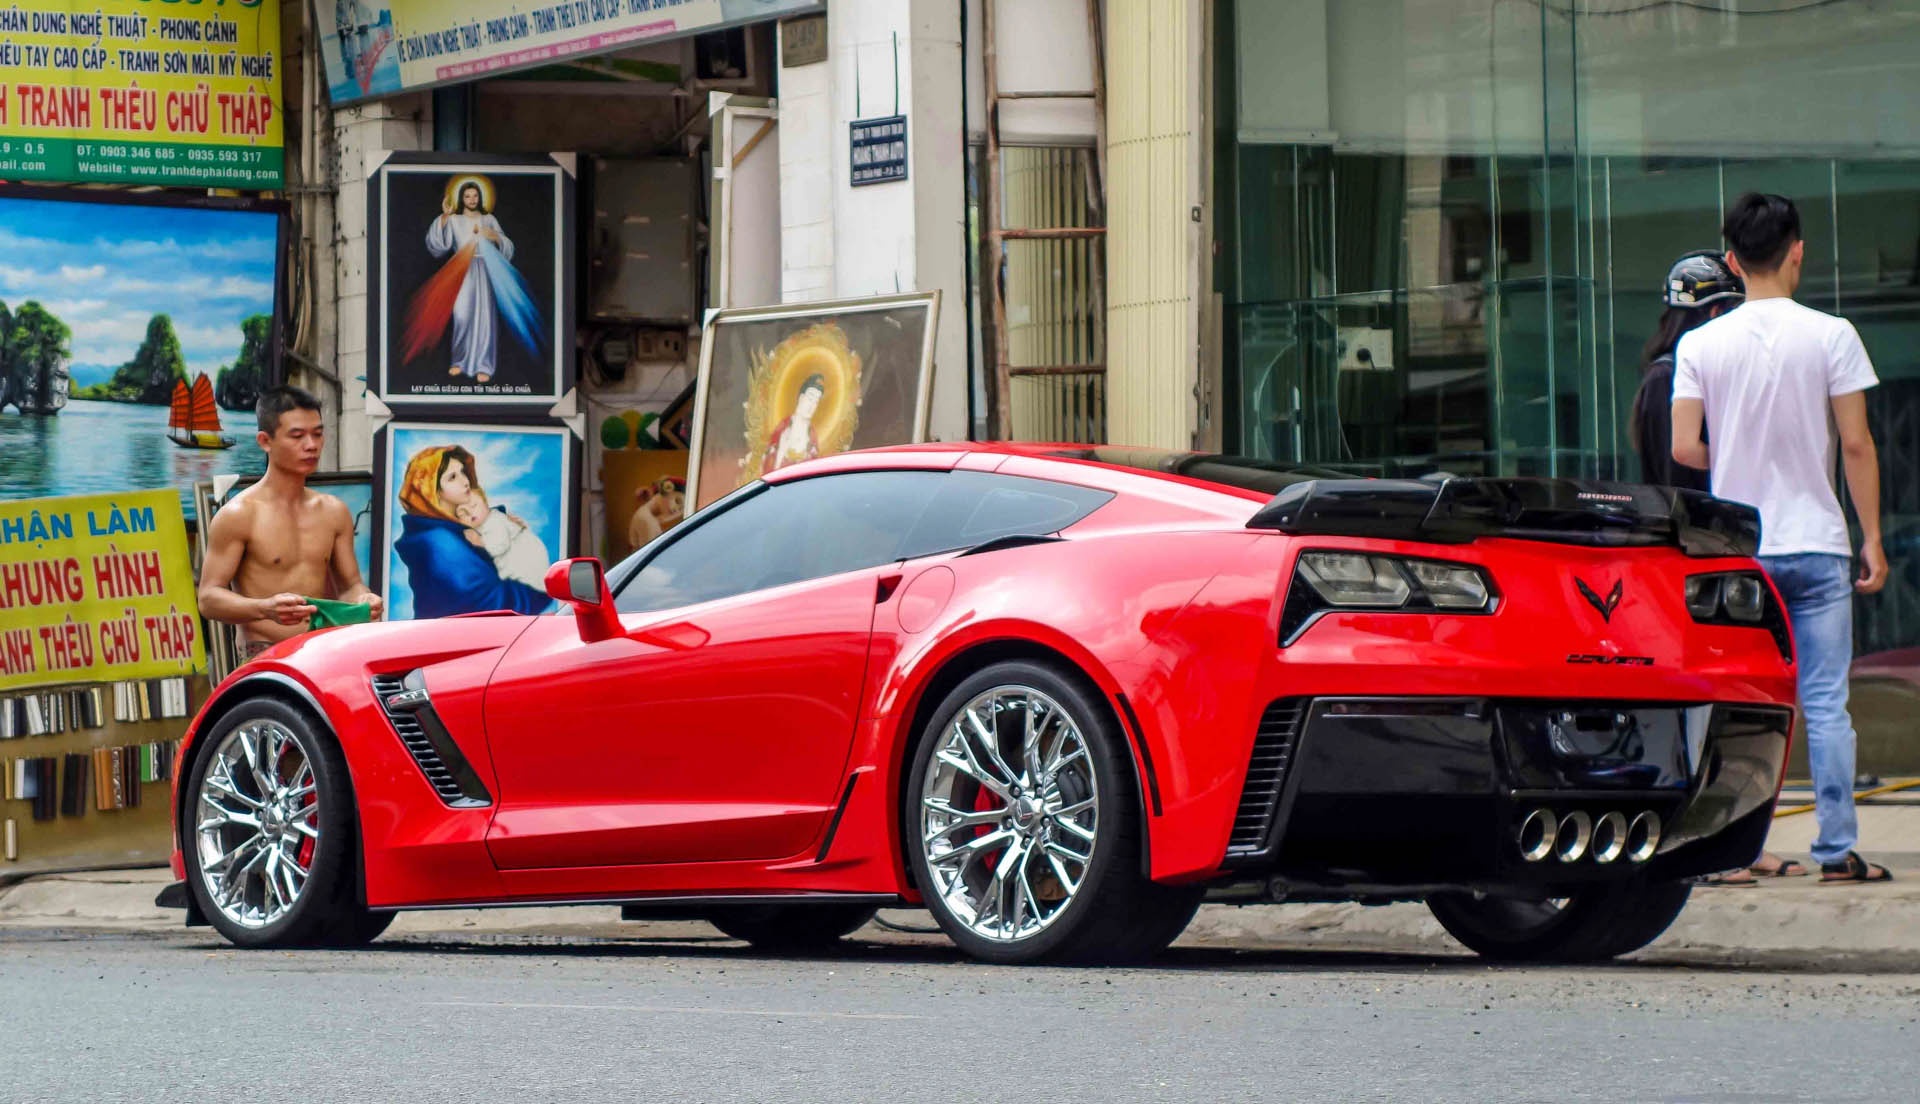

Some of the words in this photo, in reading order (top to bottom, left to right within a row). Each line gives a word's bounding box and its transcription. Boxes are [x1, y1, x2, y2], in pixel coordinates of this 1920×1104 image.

[0, 4, 28, 32] HÂN
[33, 11, 66, 34] DUNG
[108, 11, 148, 42] THUẬT
[160, 18, 201, 41] PHONG
[204, 13, 237, 42] CẢNH
[25, 45, 49, 67] TAY
[54, 47, 78, 69] CAO
[83, 39, 107, 70] CẤP
[119, 50, 159, 73] TRANH
[164, 50, 188, 74] SƠN
[192, 48, 214, 75] MÀI
[241, 51, 273, 82] NGHỆ
[17, 84, 91, 128] TRANH
[99, 79, 156, 131] THÊU
[166, 83, 209, 133] CHỮ
[217, 85, 273, 144] THẬP
[24, 142, 45, 155] Q.5
[78, 161, 127, 173] Website:
[100, 145, 151, 158] 0903.346
[155, 147, 175, 159] 685
[188, 149, 238, 161] 0935.593
[242, 151, 262, 163] 317
[0, 510, 73, 549] HẬN
[87, 503, 156, 537] LÀM
[93, 544, 163, 600] HÌNH
[39, 613, 94, 671] THÊU
[100, 608, 140, 665] CHỮ
[144, 605, 194, 667] THẬP
